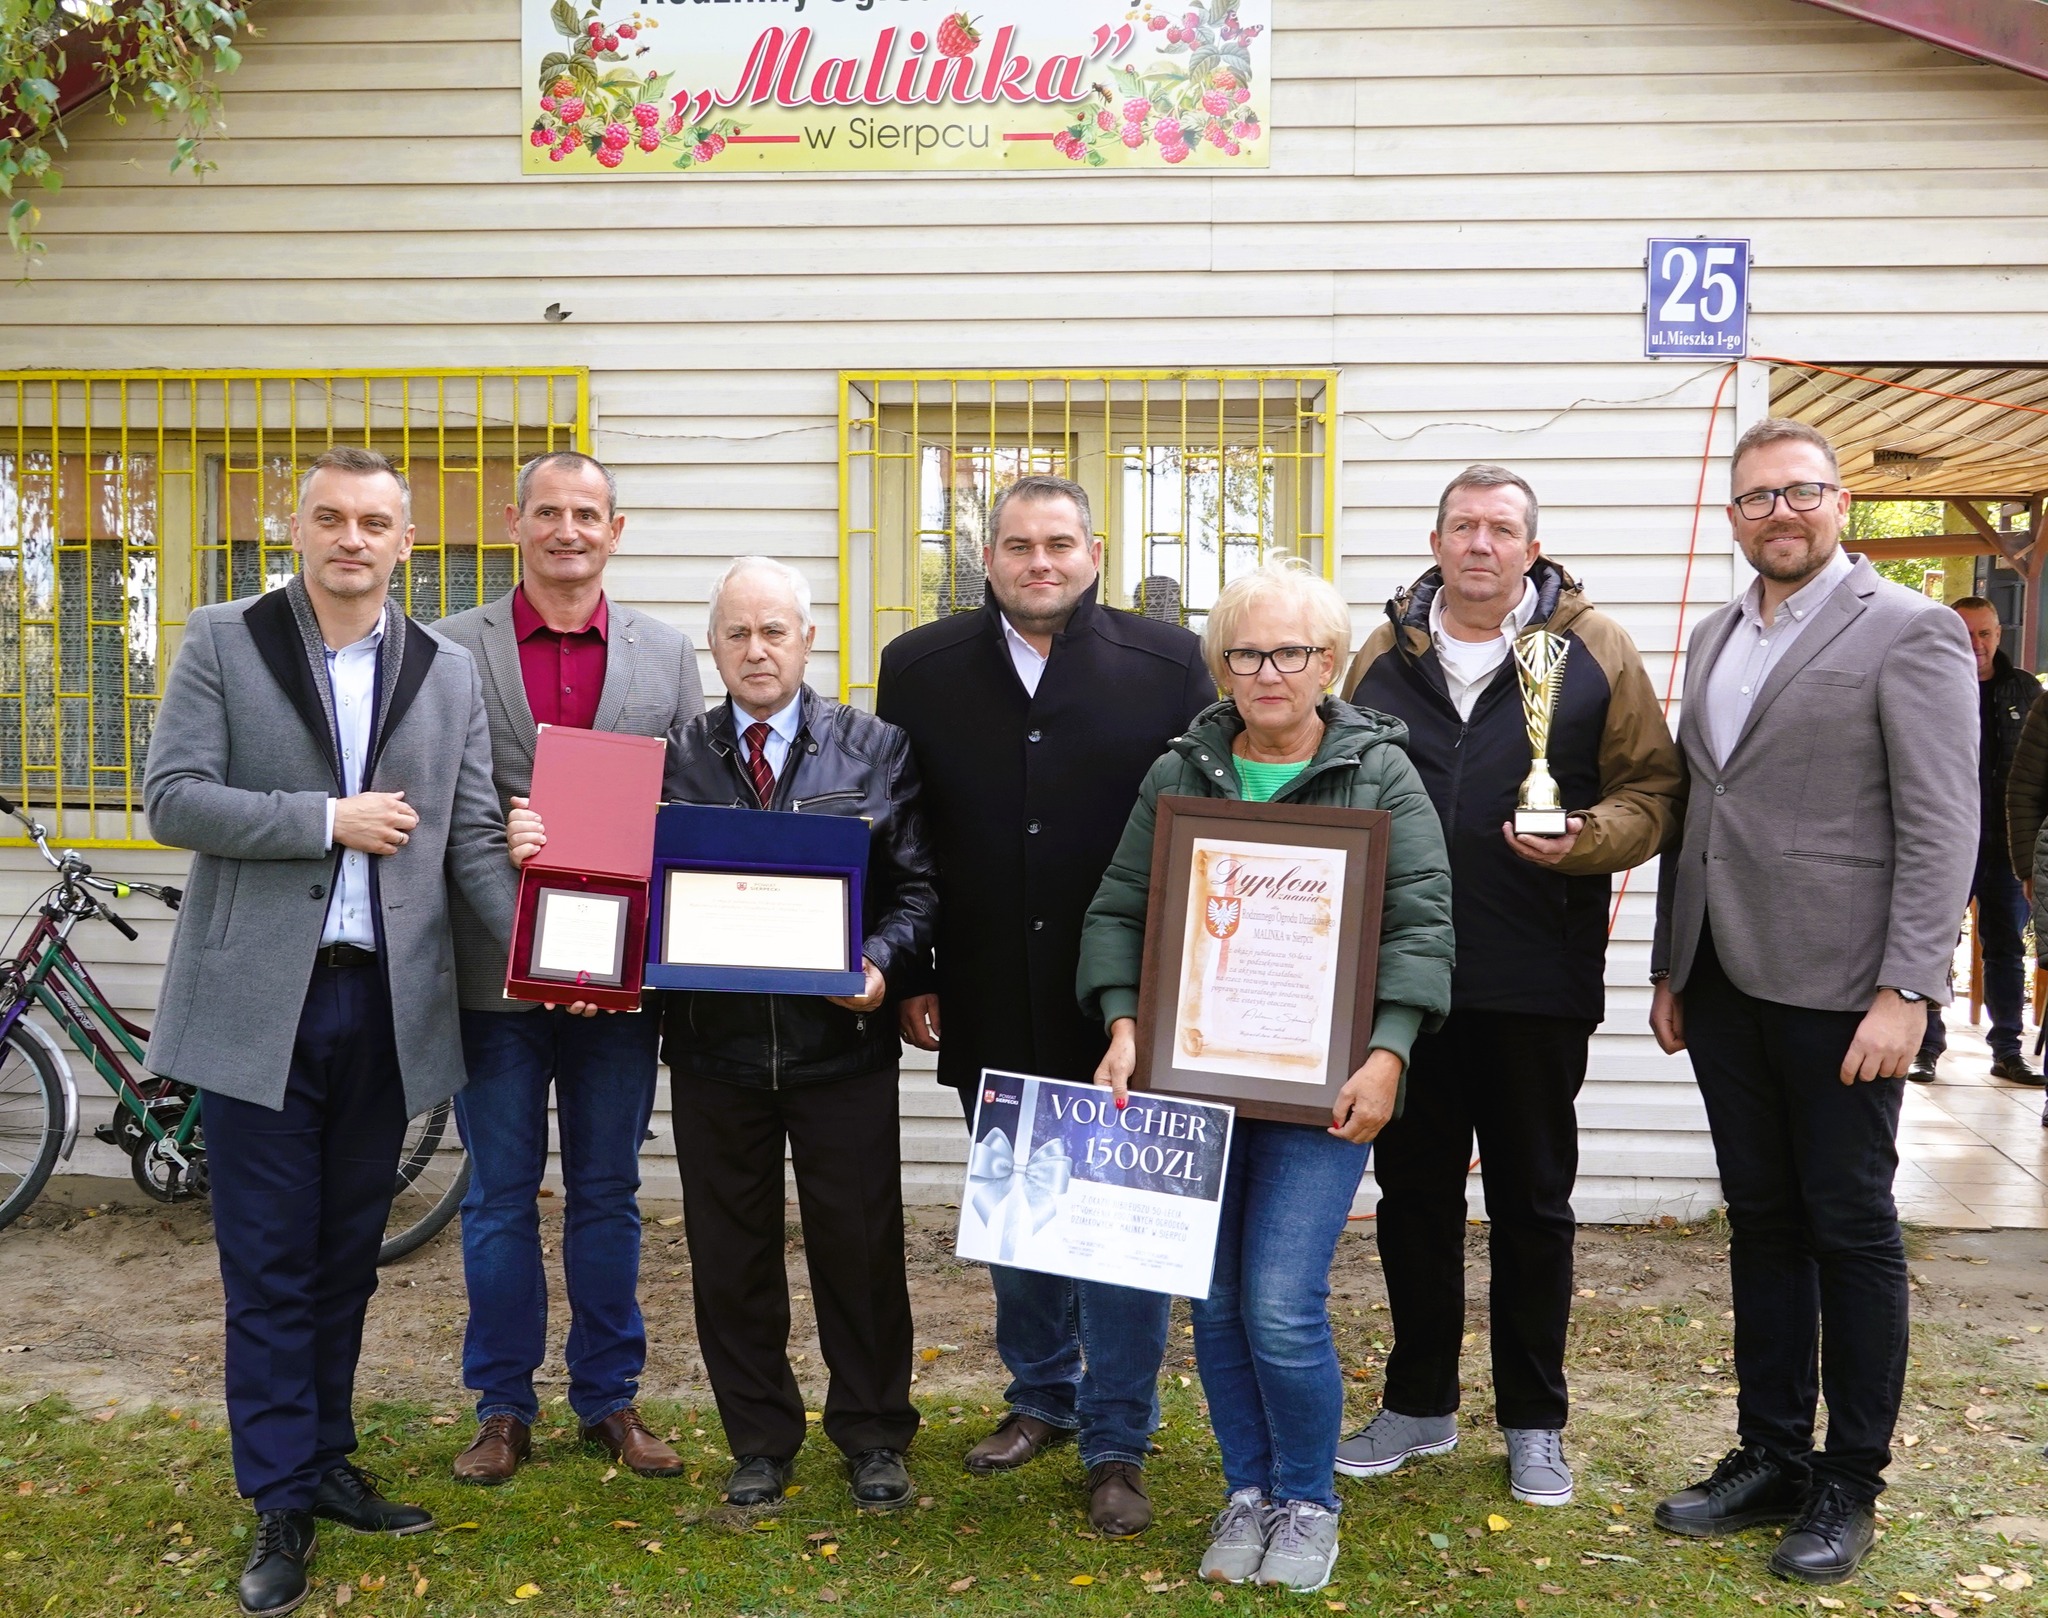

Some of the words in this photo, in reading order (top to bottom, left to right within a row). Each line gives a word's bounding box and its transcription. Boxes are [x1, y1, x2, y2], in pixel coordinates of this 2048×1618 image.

[804, 126, 838, 149] w
[848, 117, 990, 155] Sierpcu
[1659, 246, 1738, 323] 25
[1717, 331, 1741, 350] I-go
[1211, 858, 1329, 898] Dyplom
[1253, 928, 1285, 941] MALINKA
[1291, 931, 1314, 946] Sierpcu
[1276, 911, 1298, 926] Ogrodu
[1051, 1094, 1207, 1143] VOUCHER
[1085, 1136, 1203, 1181] 1500ZŁ
